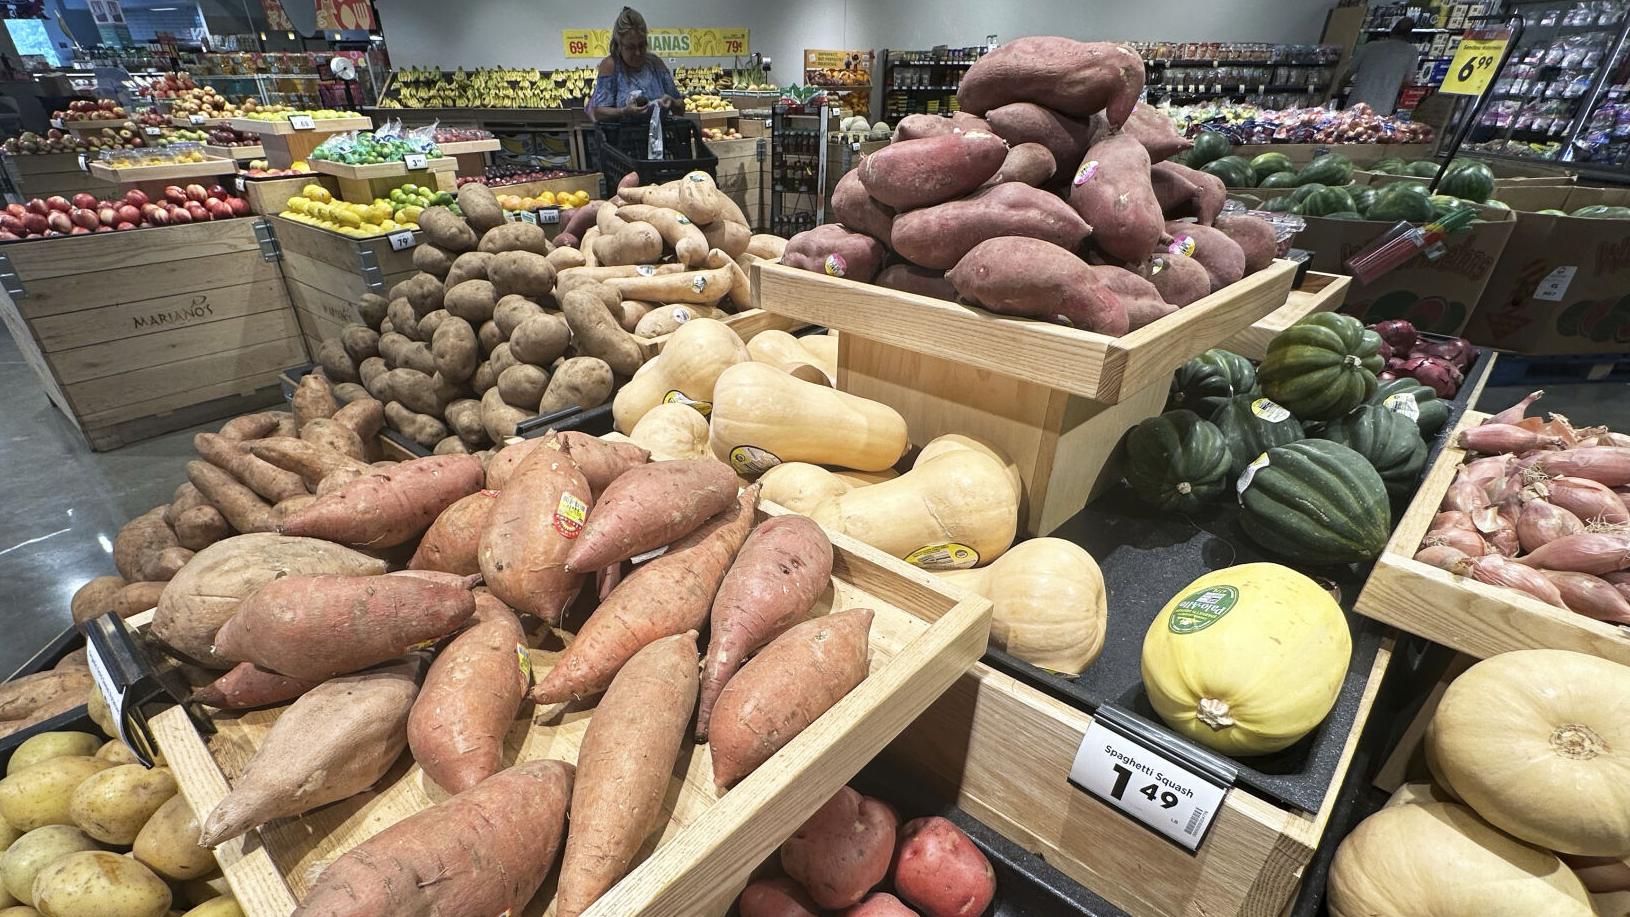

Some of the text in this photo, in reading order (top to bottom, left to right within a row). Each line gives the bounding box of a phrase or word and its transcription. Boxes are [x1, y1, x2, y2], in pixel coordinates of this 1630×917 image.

[648, 35, 690, 51] ANAS
[133, 303, 214, 329] MARIANO'S
[1104, 745, 1195, 799] Spaghetti Squash
